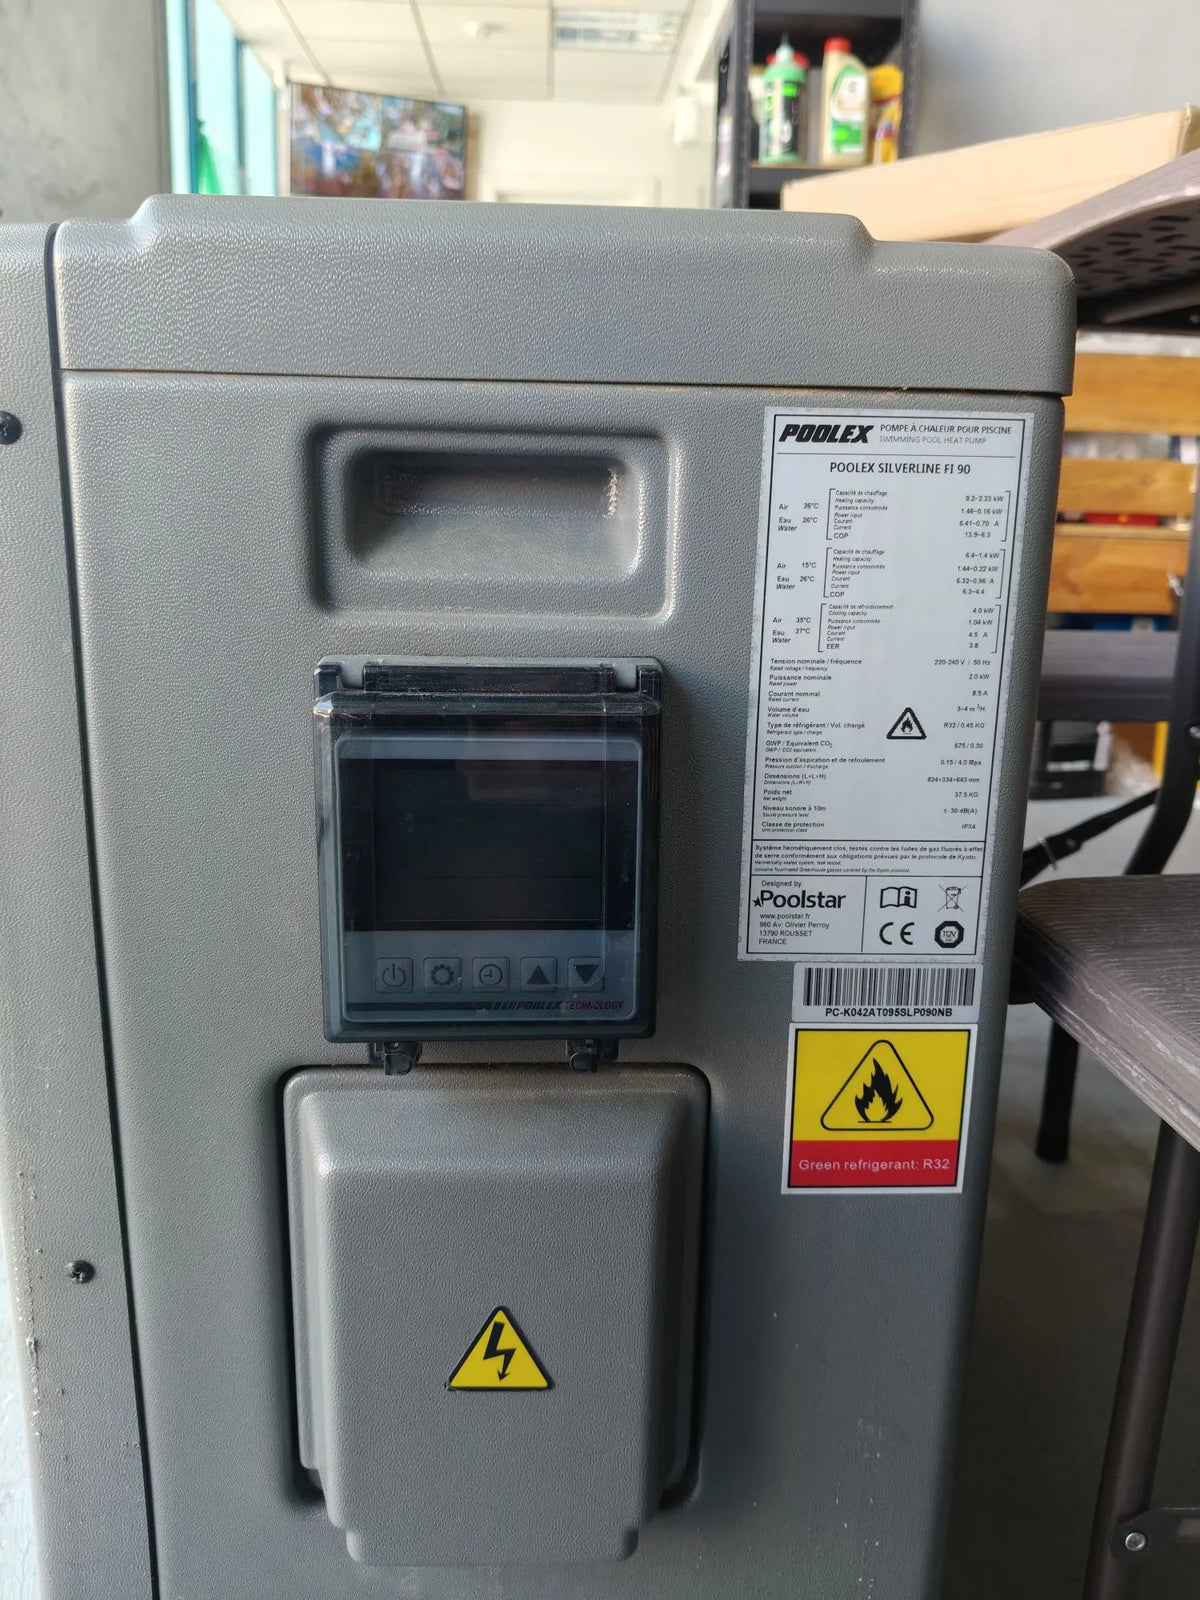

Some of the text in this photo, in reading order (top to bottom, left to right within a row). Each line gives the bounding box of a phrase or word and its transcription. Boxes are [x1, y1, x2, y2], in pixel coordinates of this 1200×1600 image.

[779, 424, 874, 444] POOLEX
[911, 423, 917, 432] À
[918, 425, 954, 433] CHALEUR
[957, 425, 979, 433] POUR
[982, 426, 1012, 434] PISCINE
[830, 462, 970, 474] POOLEX SILVERLINE FI 90
[760, 890, 846, 908] Poolstar
[879, 922, 915, 945] CE
[825, 1008, 953, 1017] PC-K042AT095SLP090NB
[799, 1159, 950, 1171] Green refrigerant: R32
